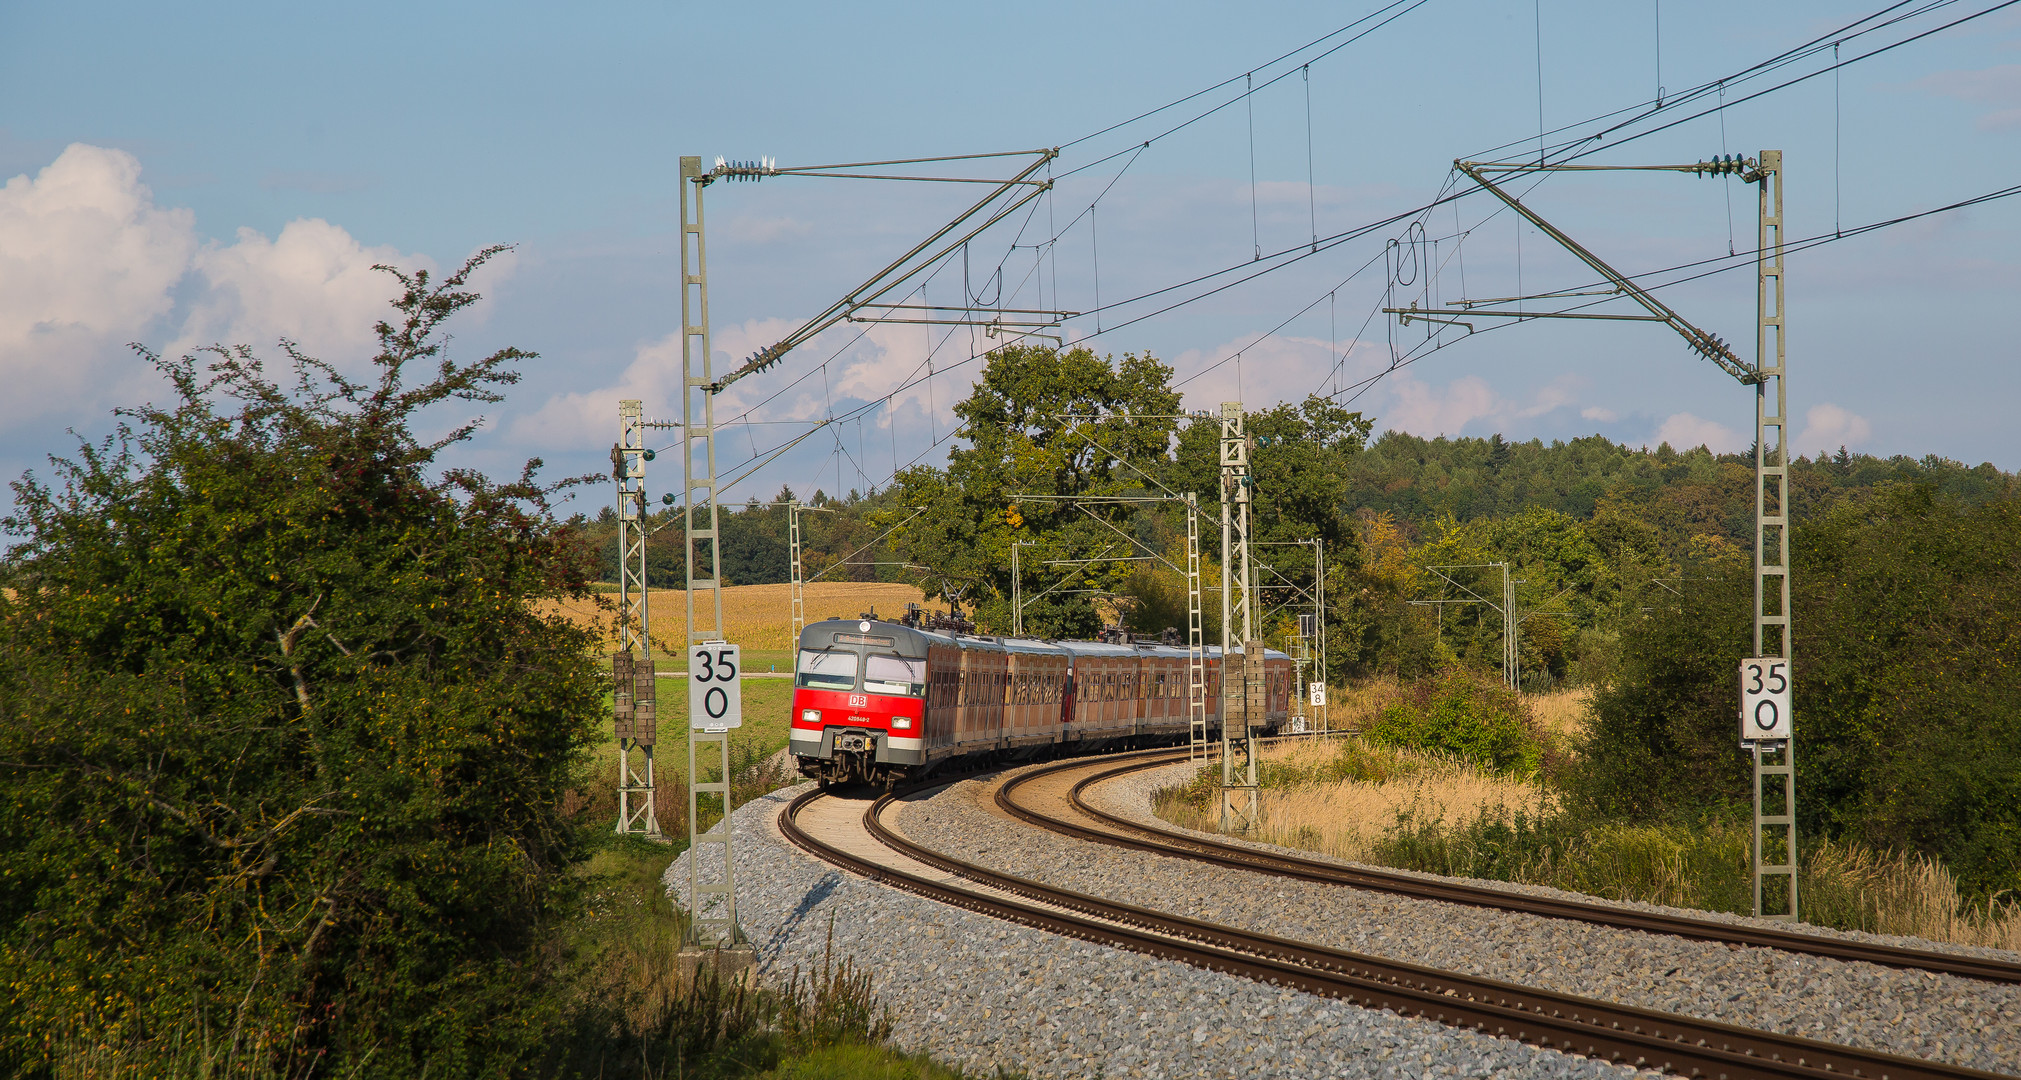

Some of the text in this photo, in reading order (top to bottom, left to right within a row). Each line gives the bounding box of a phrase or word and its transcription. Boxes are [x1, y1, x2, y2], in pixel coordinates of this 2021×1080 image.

[695, 650, 736, 682] 35
[1746, 663, 1787, 695] 35
[704, 686, 728, 719] 0
[850, 695, 866, 706] DB
[1311, 684, 1324, 693] 34
[1314, 694, 1321, 704] 8
[1754, 699, 1779, 731] 0
